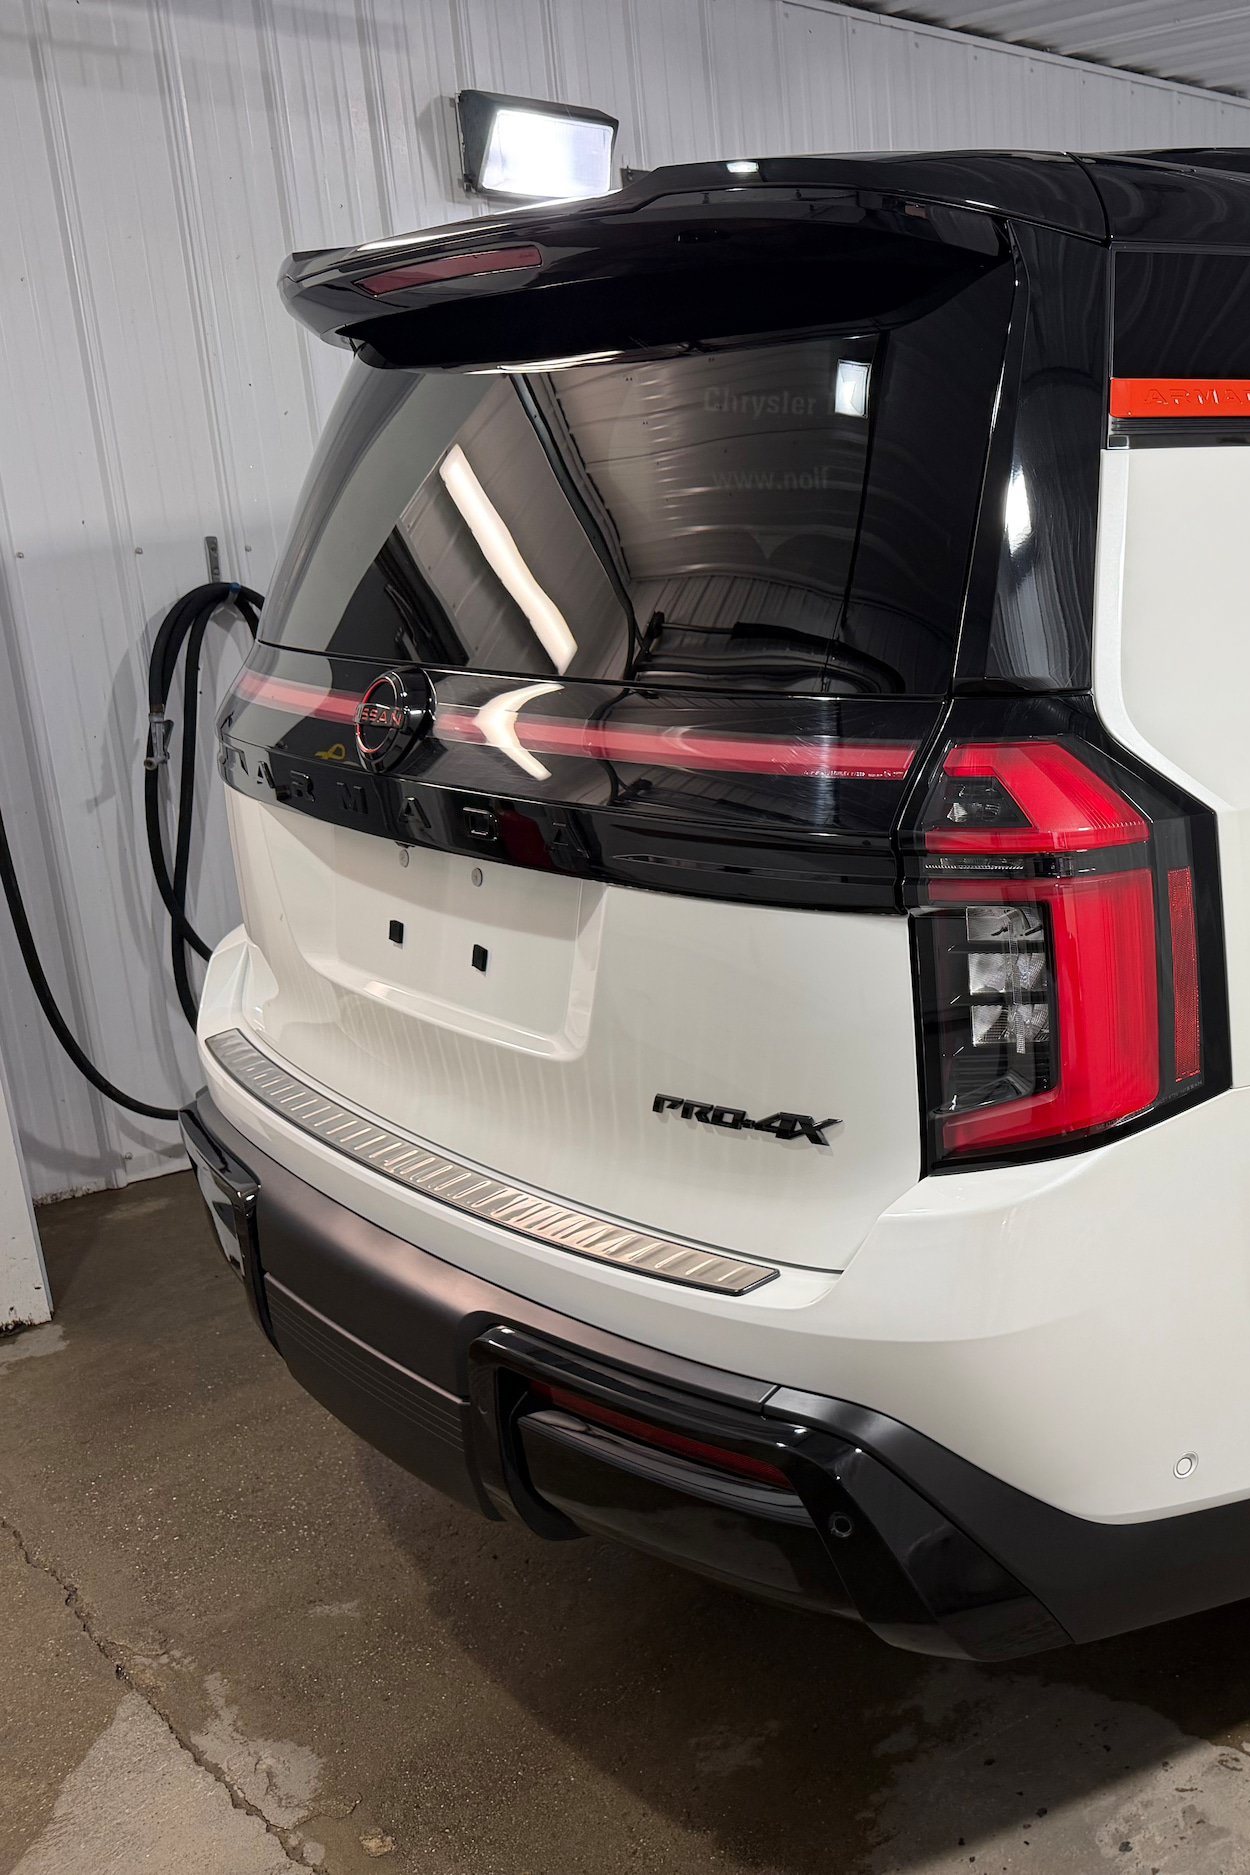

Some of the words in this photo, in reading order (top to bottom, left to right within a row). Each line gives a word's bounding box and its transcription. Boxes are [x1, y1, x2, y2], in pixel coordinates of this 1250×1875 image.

[703, 385, 817, 421] Chrysler
[252, 758, 592, 860] ARMADA
[652, 1093, 843, 1147] PRO-4X
